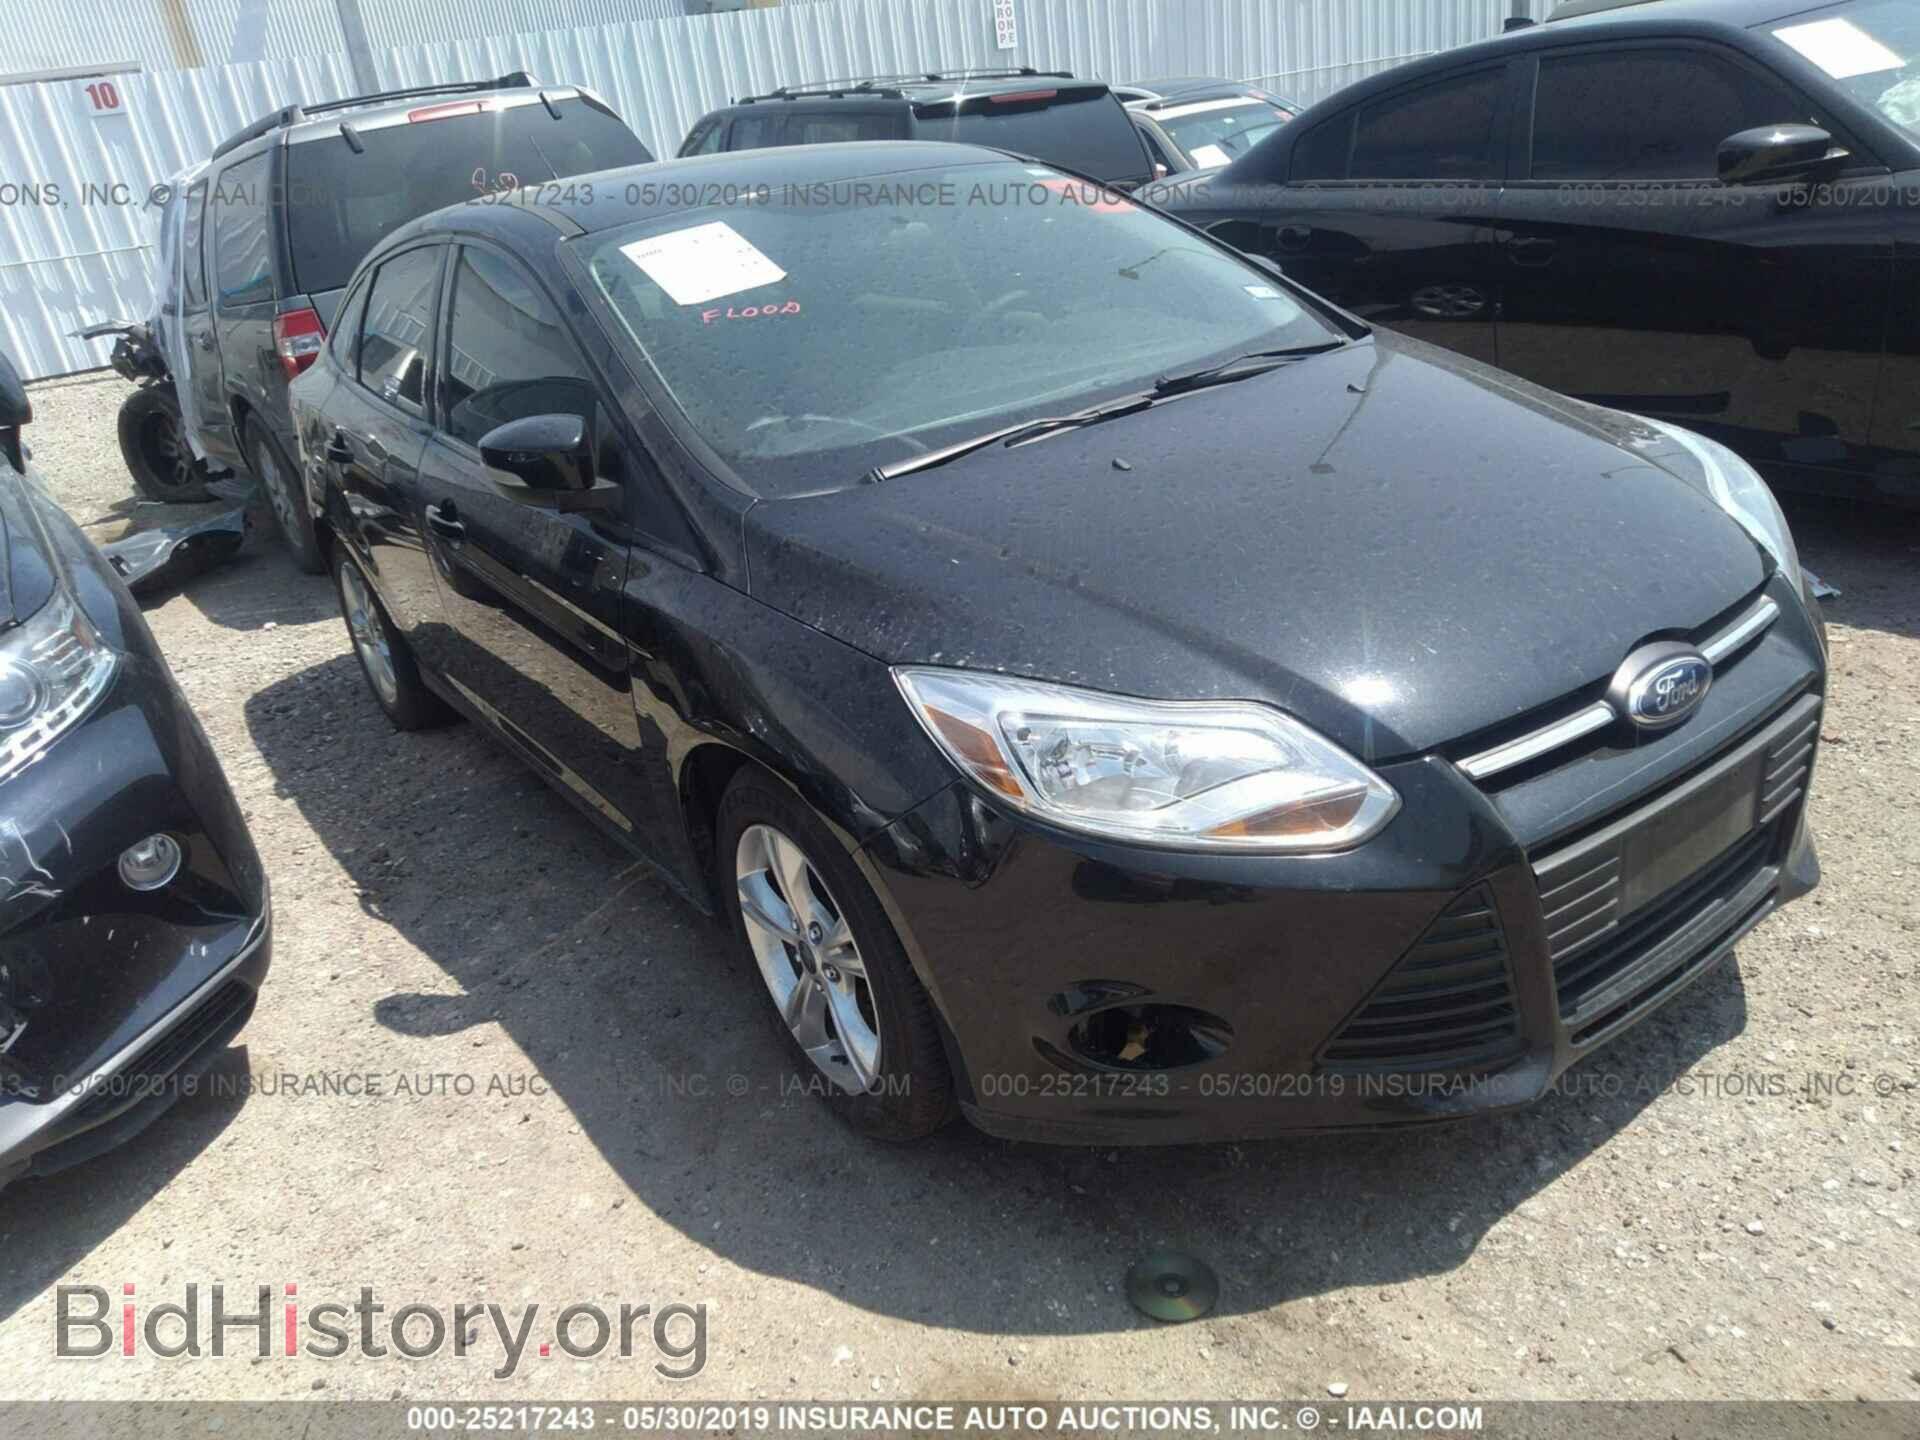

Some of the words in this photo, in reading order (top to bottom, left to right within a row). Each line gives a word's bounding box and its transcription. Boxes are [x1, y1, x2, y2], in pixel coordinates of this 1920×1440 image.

[85, 82, 119, 110] 10
[702, 301, 800, 325] FLOOD
[1656, 669, 1696, 712] Ford
